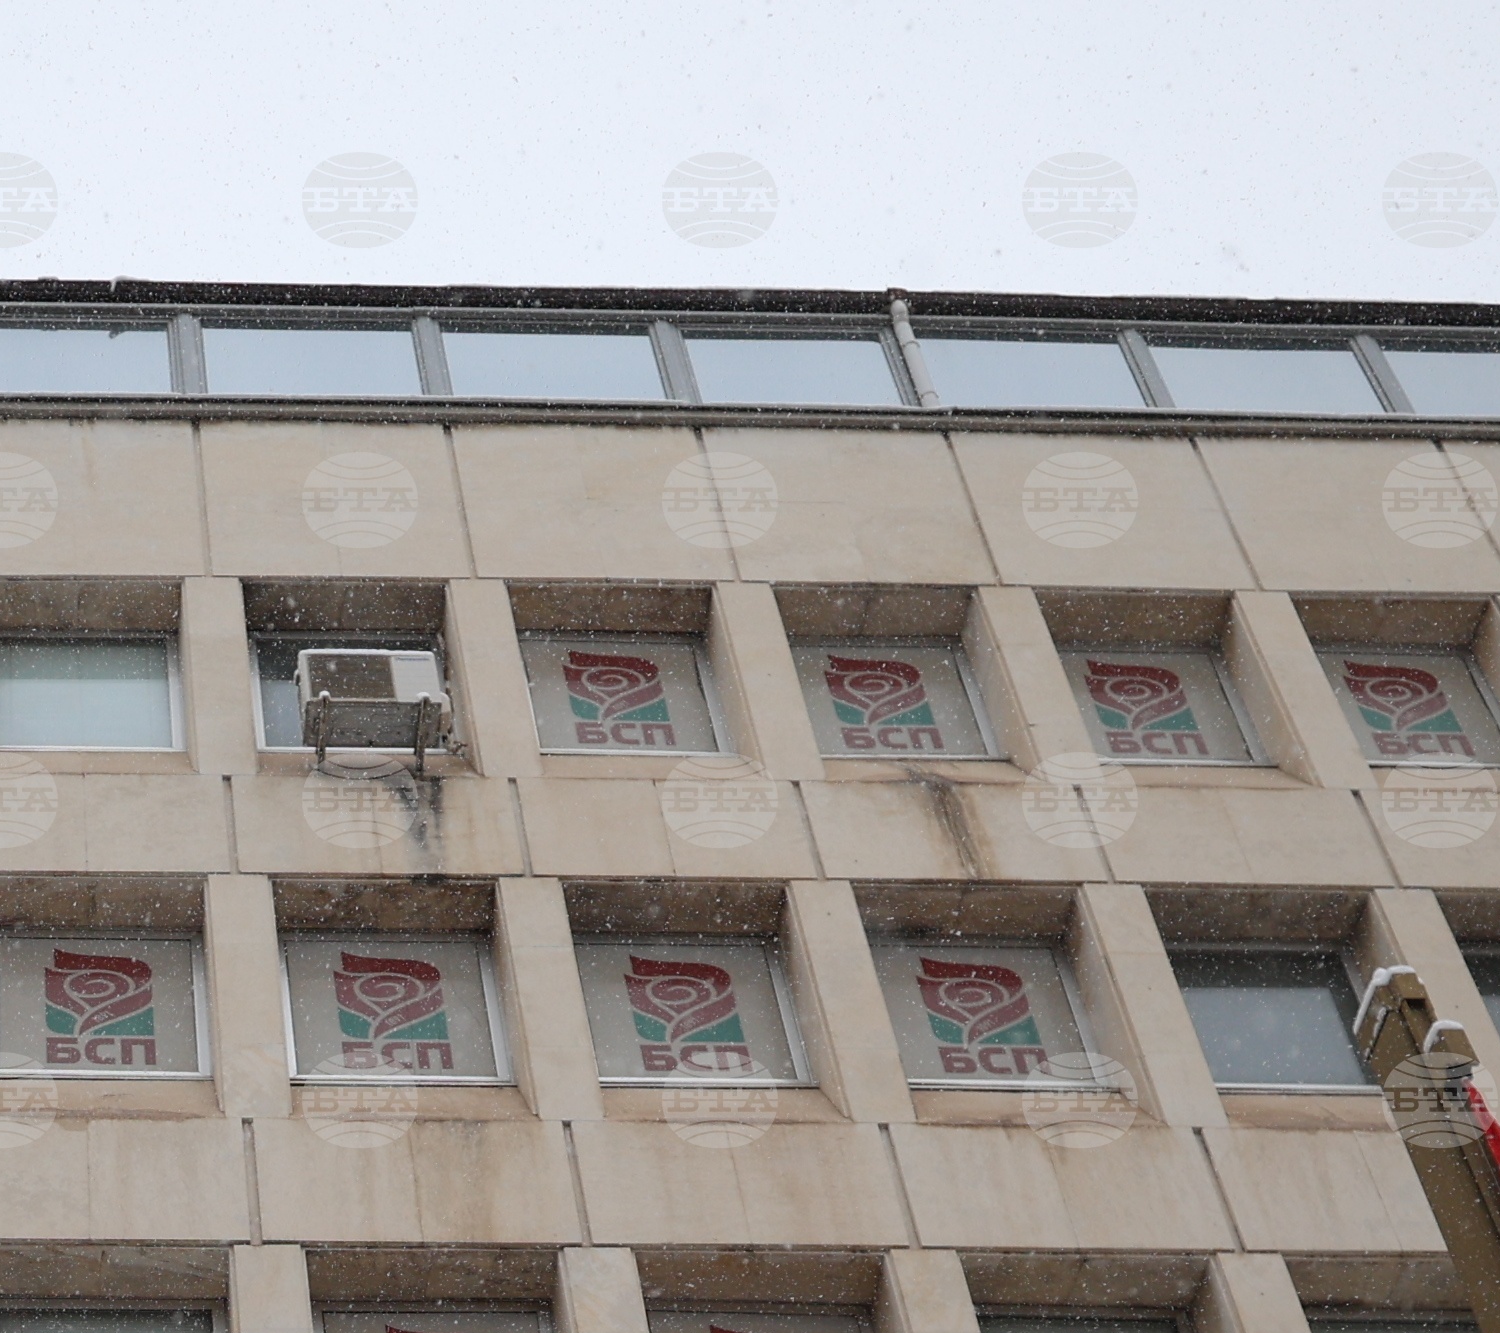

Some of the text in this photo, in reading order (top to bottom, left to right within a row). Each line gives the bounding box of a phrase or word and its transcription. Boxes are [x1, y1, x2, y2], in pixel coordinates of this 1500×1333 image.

[577, 722, 676, 746] БСП
[842, 726, 944, 750] БСП
[1105, 731, 1209, 755] БСП
[1373, 732, 1475, 755] БСП
[46, 1037, 156, 1065] БСП
[343, 1043, 453, 1070] БСП
[640, 1044, 752, 1072] БСП
[939, 1046, 1049, 1074] БСП
